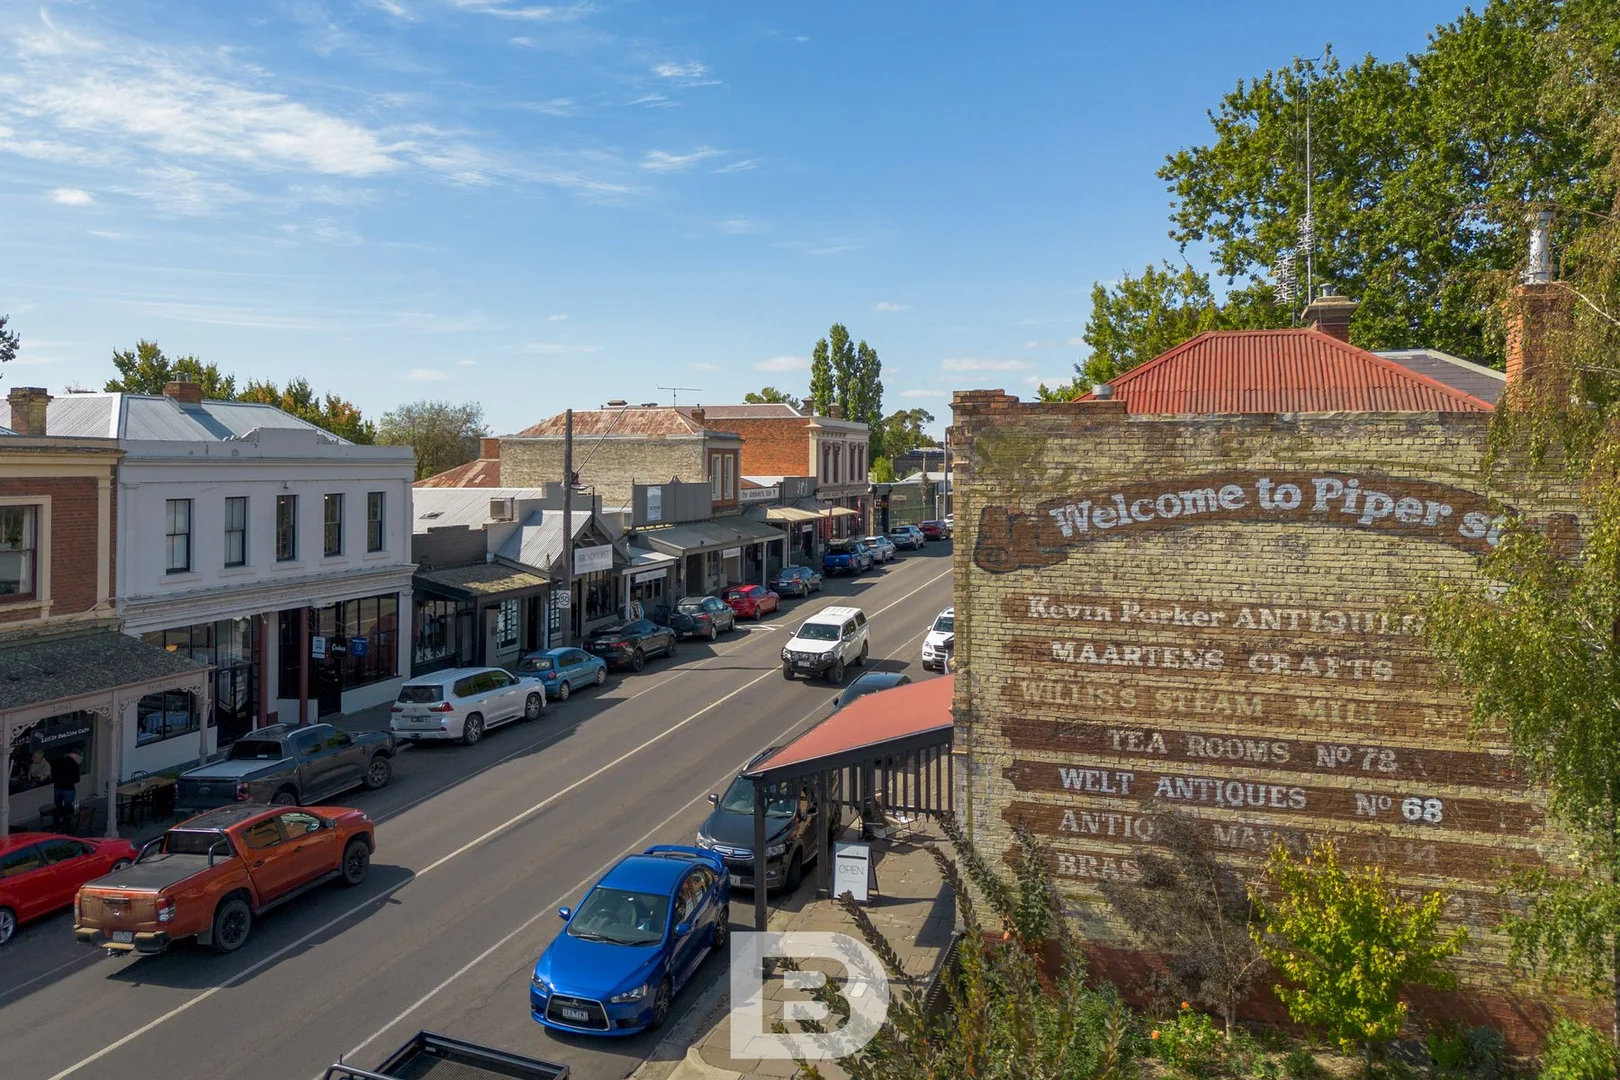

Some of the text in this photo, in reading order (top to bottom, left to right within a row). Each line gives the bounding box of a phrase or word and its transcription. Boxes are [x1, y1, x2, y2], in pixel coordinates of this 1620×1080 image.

[1050, 483, 1245, 537] Welcome
[1256, 477, 1302, 511] to
[1312, 478, 1453, 526] Piper
[1027, 596, 1113, 621] Kevin
[1119, 601, 1225, 627] Parker
[1050, 640, 1394, 680] MAARTENS CRAFTS
[1107, 729, 1167, 754] TEA
[1185, 733, 1291, 763] ROOMS
[1057, 766, 1134, 795] WELT
[1153, 776, 1307, 809] ANTIQUES
[1401, 797, 1444, 823] 68
[838, 864, 865, 876] OPEN
[1056, 852, 1141, 883] BRAS
